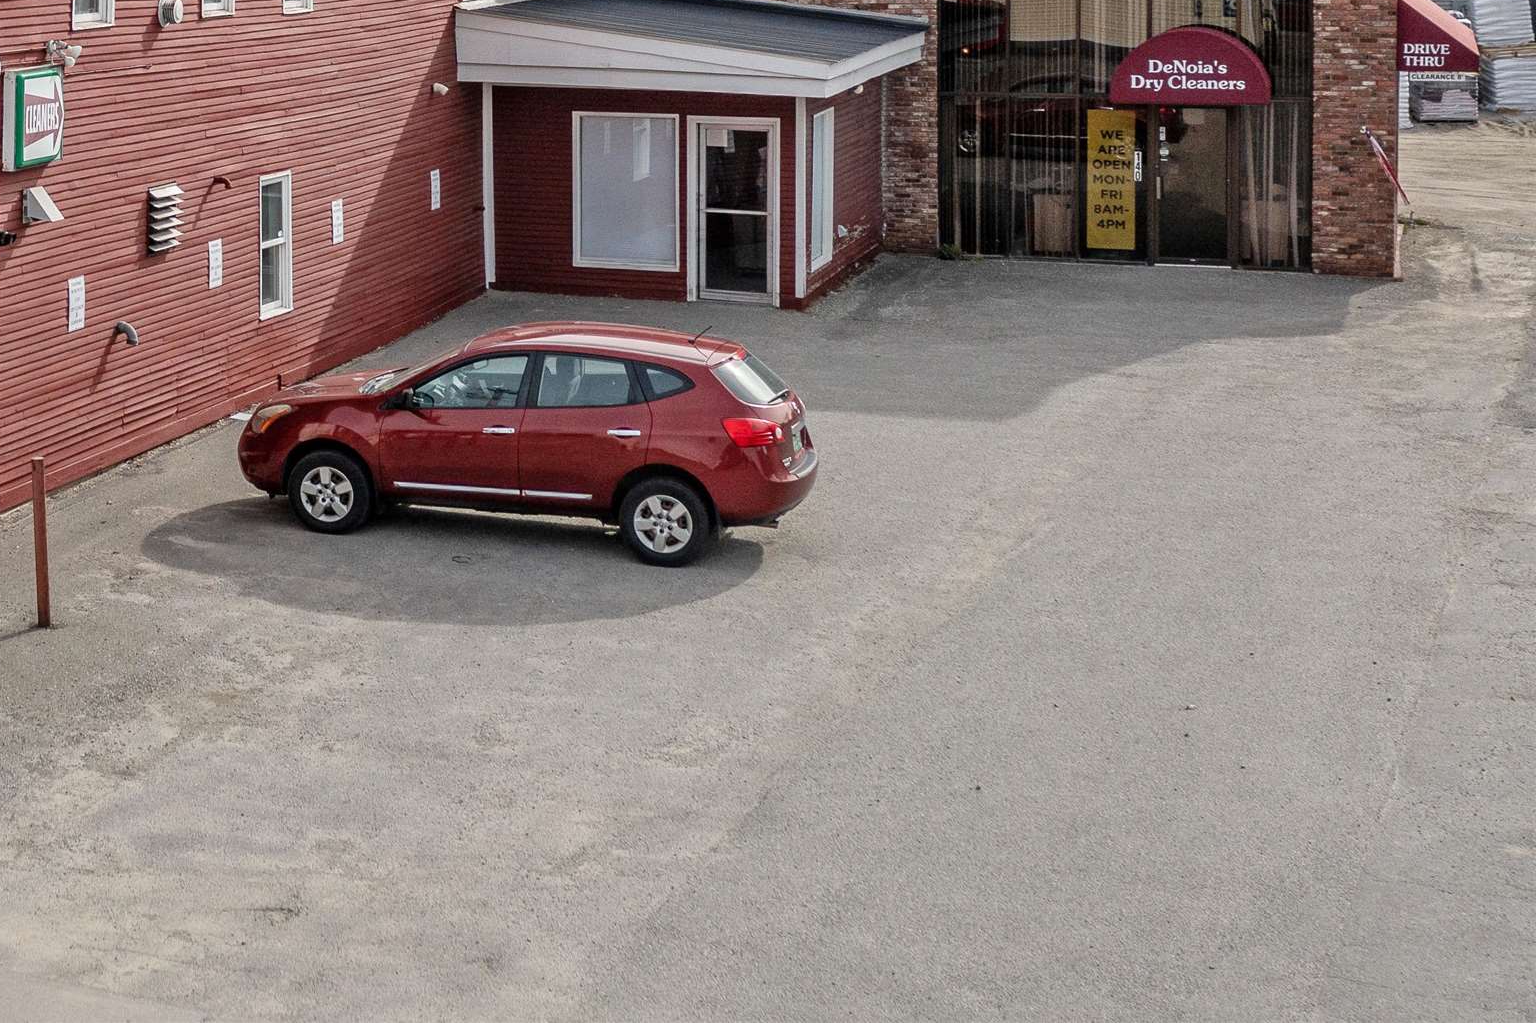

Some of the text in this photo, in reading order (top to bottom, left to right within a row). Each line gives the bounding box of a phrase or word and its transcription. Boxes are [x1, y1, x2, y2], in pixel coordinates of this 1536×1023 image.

[1403, 43, 1451, 55] DRIVE
[1147, 59, 1228, 74] DeNoia's
[1403, 55, 1445, 67] THRU
[1130, 74, 1246, 92] Dry Cleaners
[25, 102, 60, 134] CLEANERS
[1100, 129, 1124, 140] WE
[1097, 145, 1125, 155] ARE
[1092, 159, 1131, 170] OPEN
[1134, 152, 1142, 181] 140
[1092, 174, 1131, 185] MON-
[1100, 189, 1123, 200] FRI
[1093, 204, 1130, 215] 8AM-
[1096, 219, 1126, 230] 4PM
